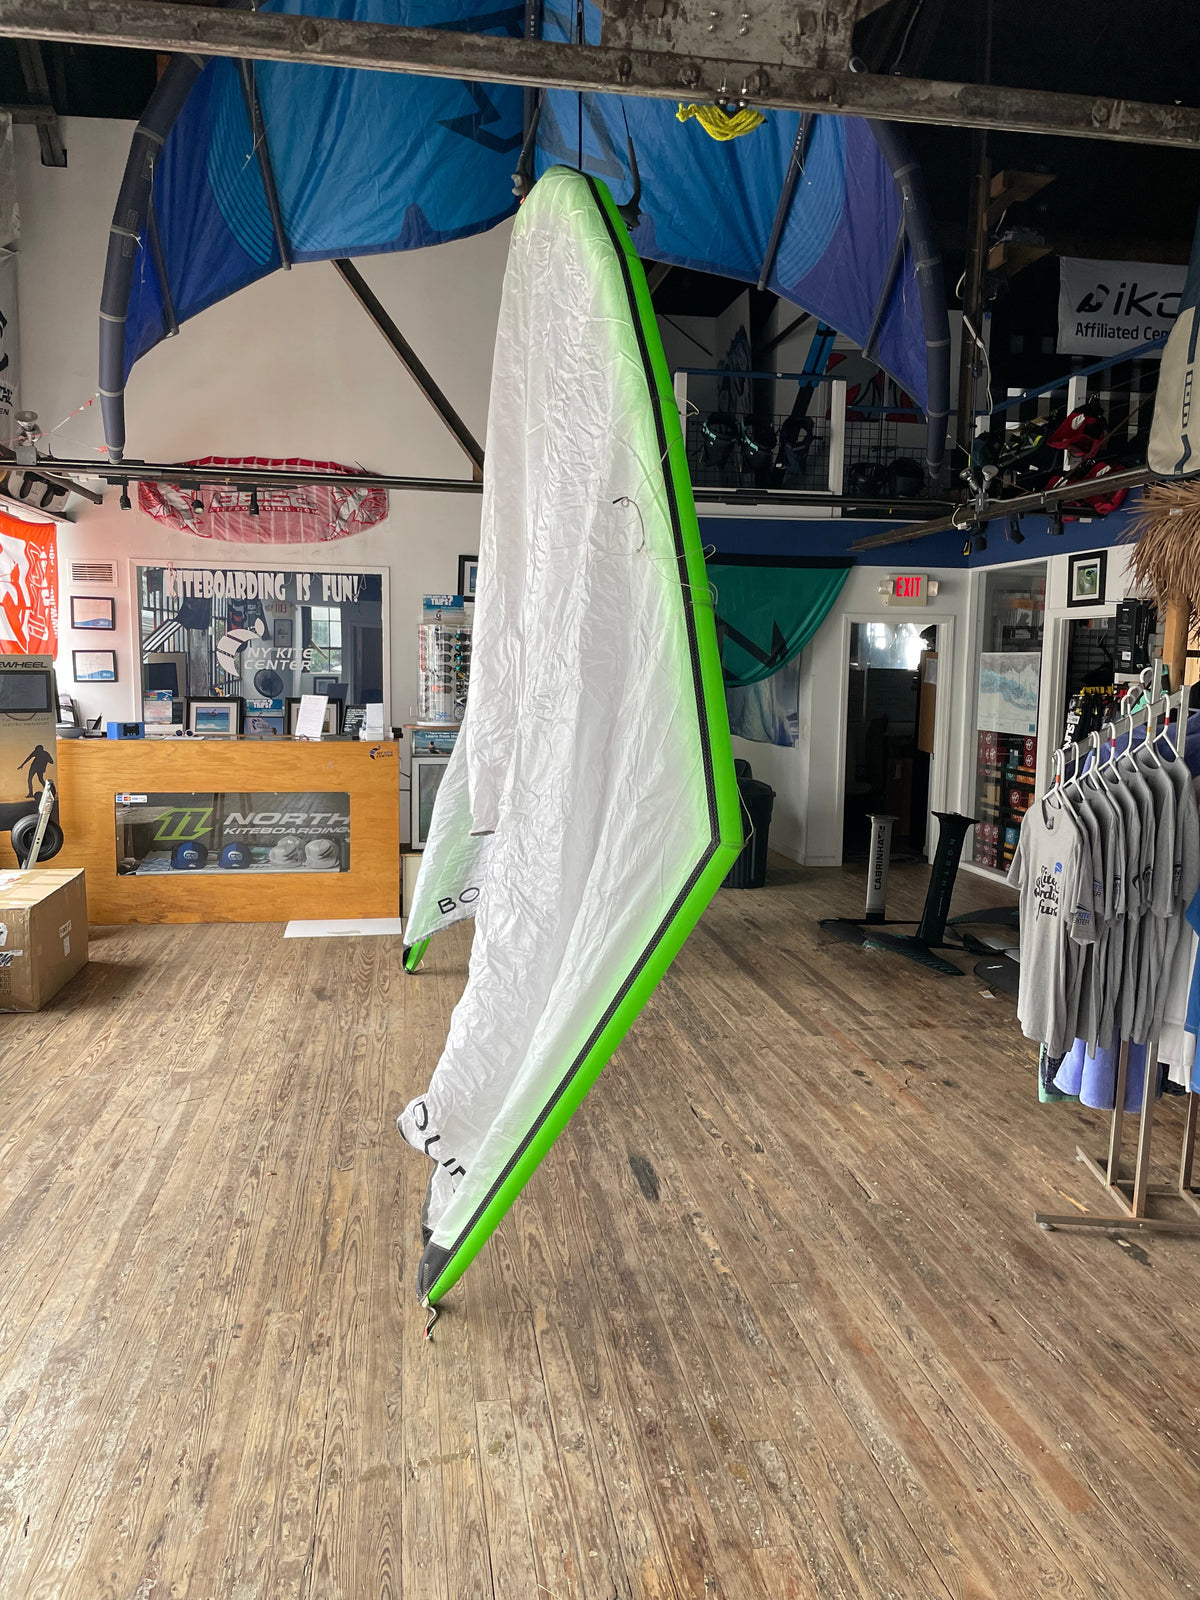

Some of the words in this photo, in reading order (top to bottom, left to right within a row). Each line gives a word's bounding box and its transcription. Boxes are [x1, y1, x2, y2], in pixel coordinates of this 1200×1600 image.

[1075, 322, 1139, 341] Affiliated
[208, 505, 321, 515] KITEBORDING.COM
[163, 569, 286, 600] KITEBOARDING
[296, 574, 311, 601] IS
[322, 575, 359, 602] FUN!
[896, 576, 922, 597] EXIT
[248, 648, 272, 658] NY
[276, 648, 312, 659] KITE
[244, 660, 312, 670] CENTER
[223, 812, 350, 825] NORTH
[223, 827, 346, 835] KITEBOARDING
[874, 838, 885, 891] CABRINHA
[941, 838, 956, 886] NORTH
